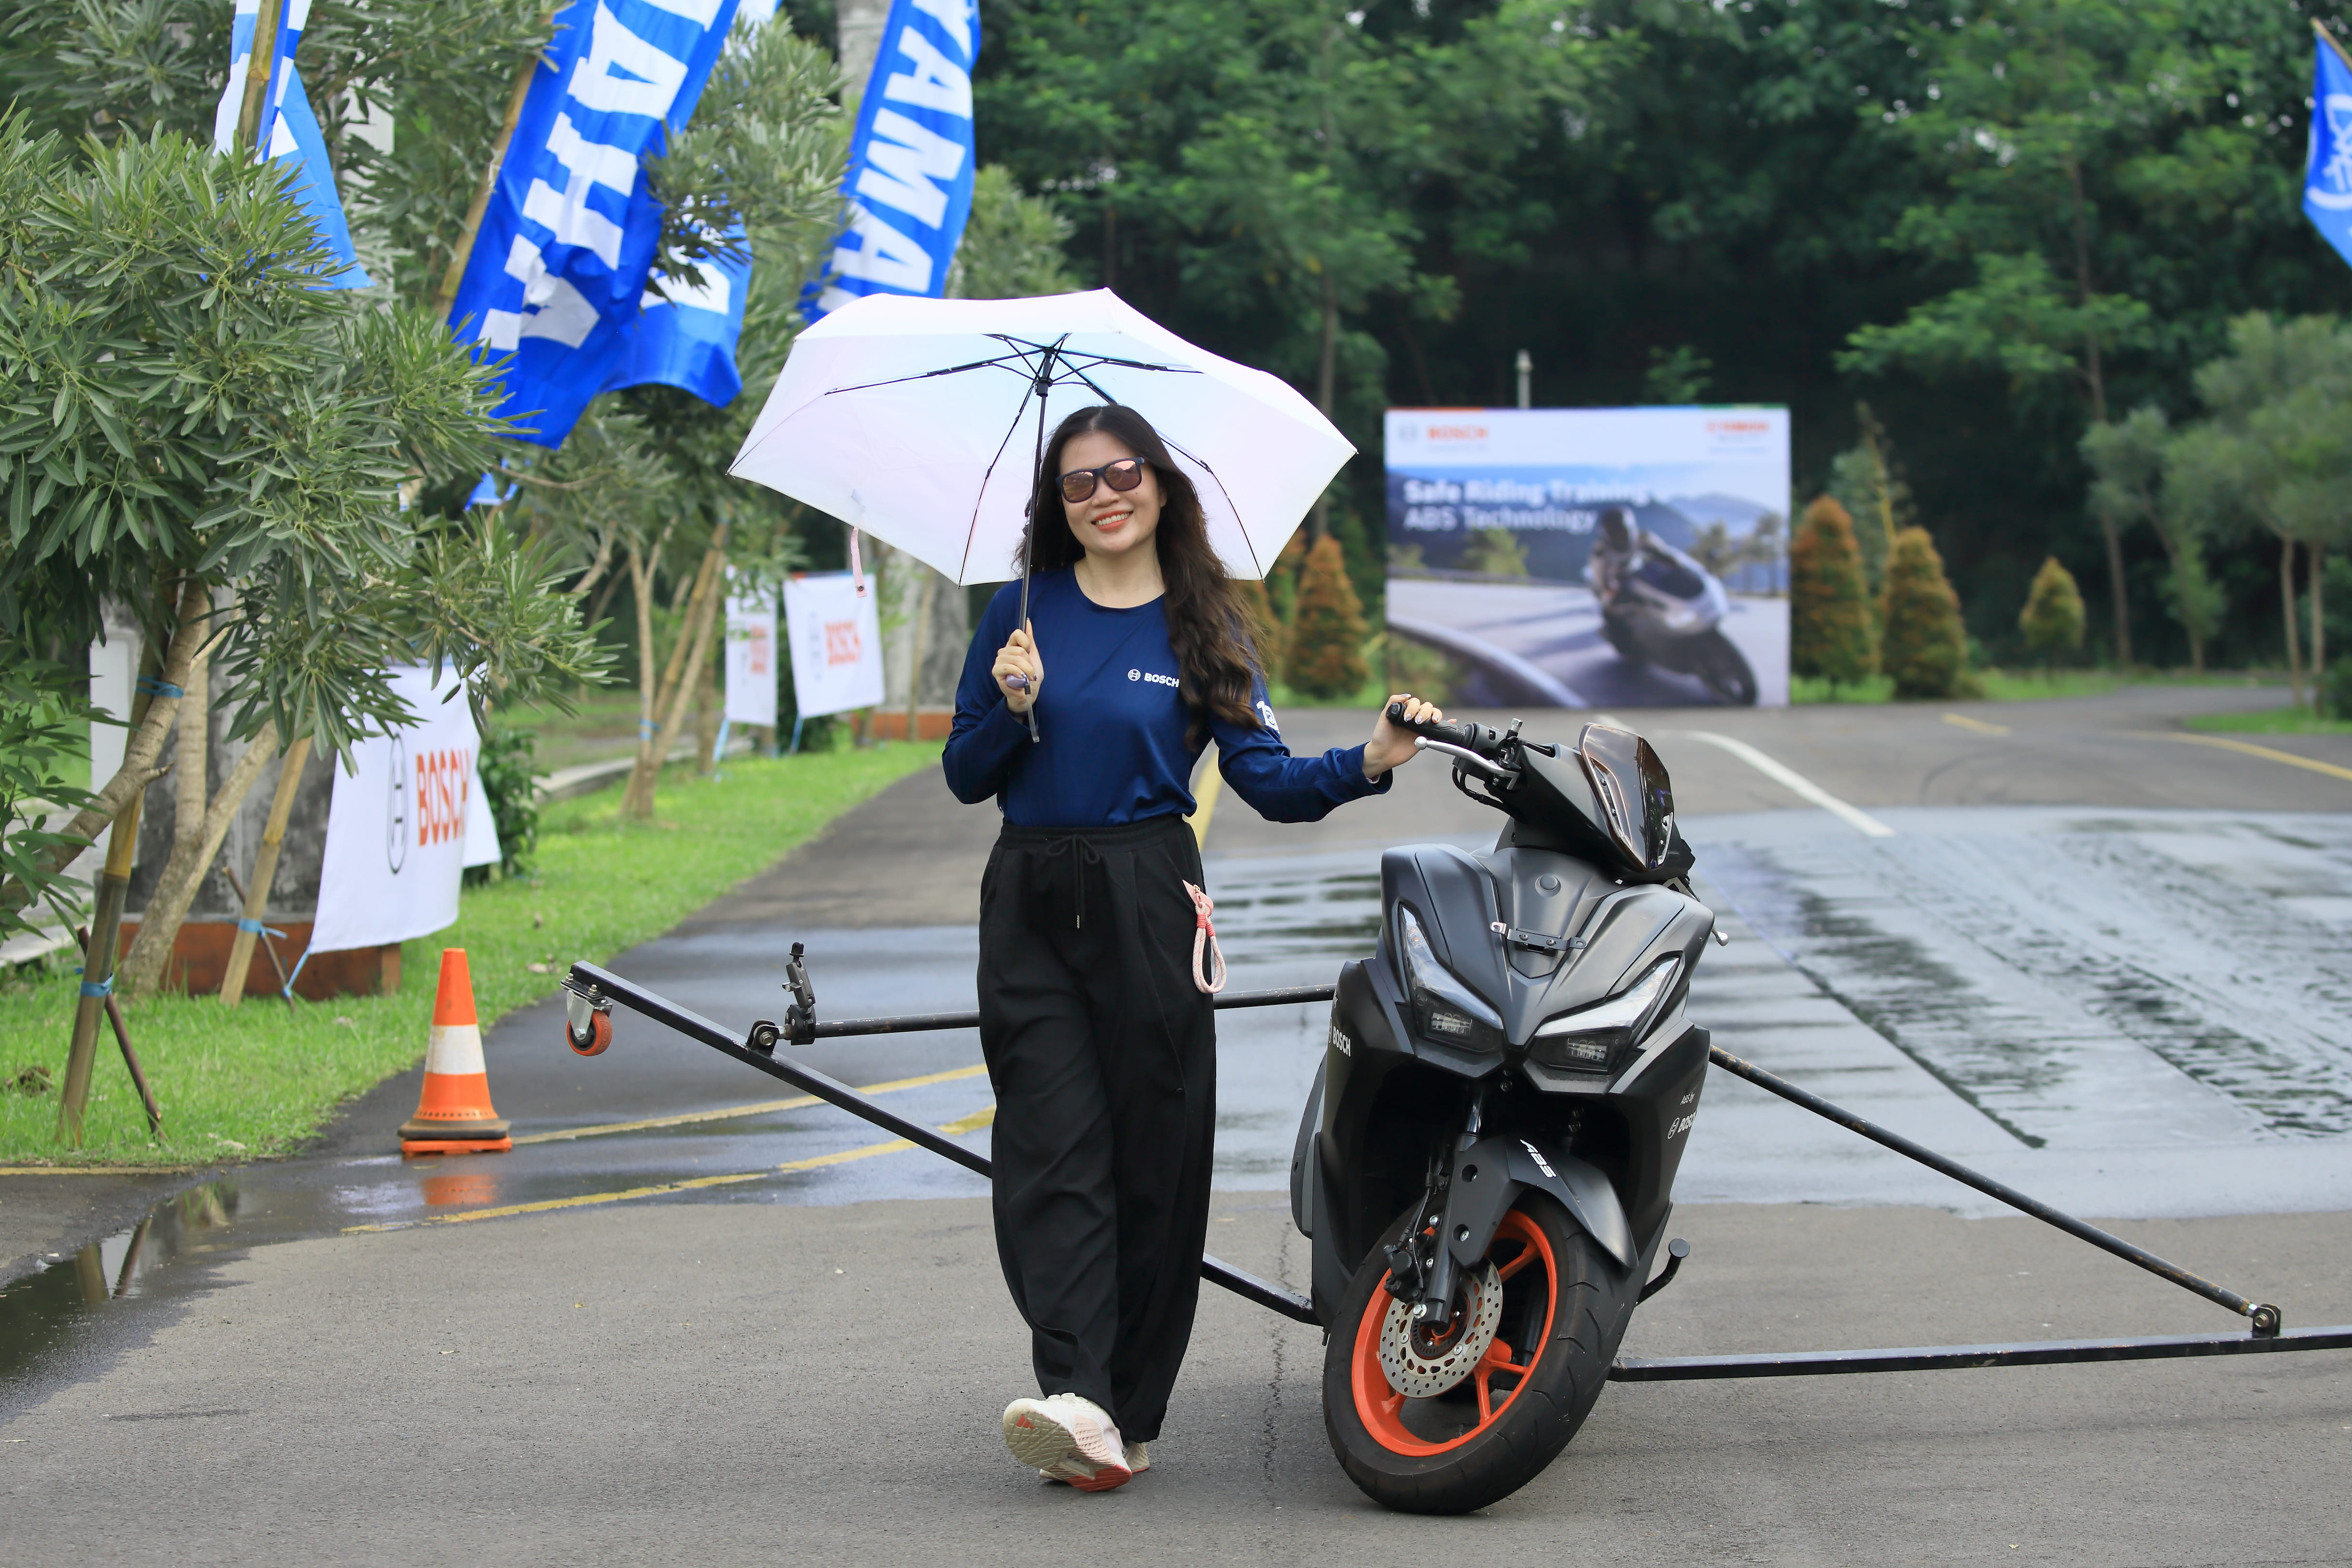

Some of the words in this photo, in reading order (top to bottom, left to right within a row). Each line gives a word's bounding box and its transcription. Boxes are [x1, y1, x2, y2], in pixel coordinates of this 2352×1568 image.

[817, 0, 973, 313] YAMA
[1403, 480, 1461, 504] Safe
[1464, 480, 1545, 507] Riding
[1551, 480, 1649, 507] Training
[1404, 506, 1457, 530] ABS
[1462, 507, 1596, 534] Technology
[1144, 672, 1180, 688] BOSCH
[416, 748, 470, 846] BOSCH
[1333, 1026, 1351, 1057] BOSCH
[1520, 1139, 1556, 1178] ABS
